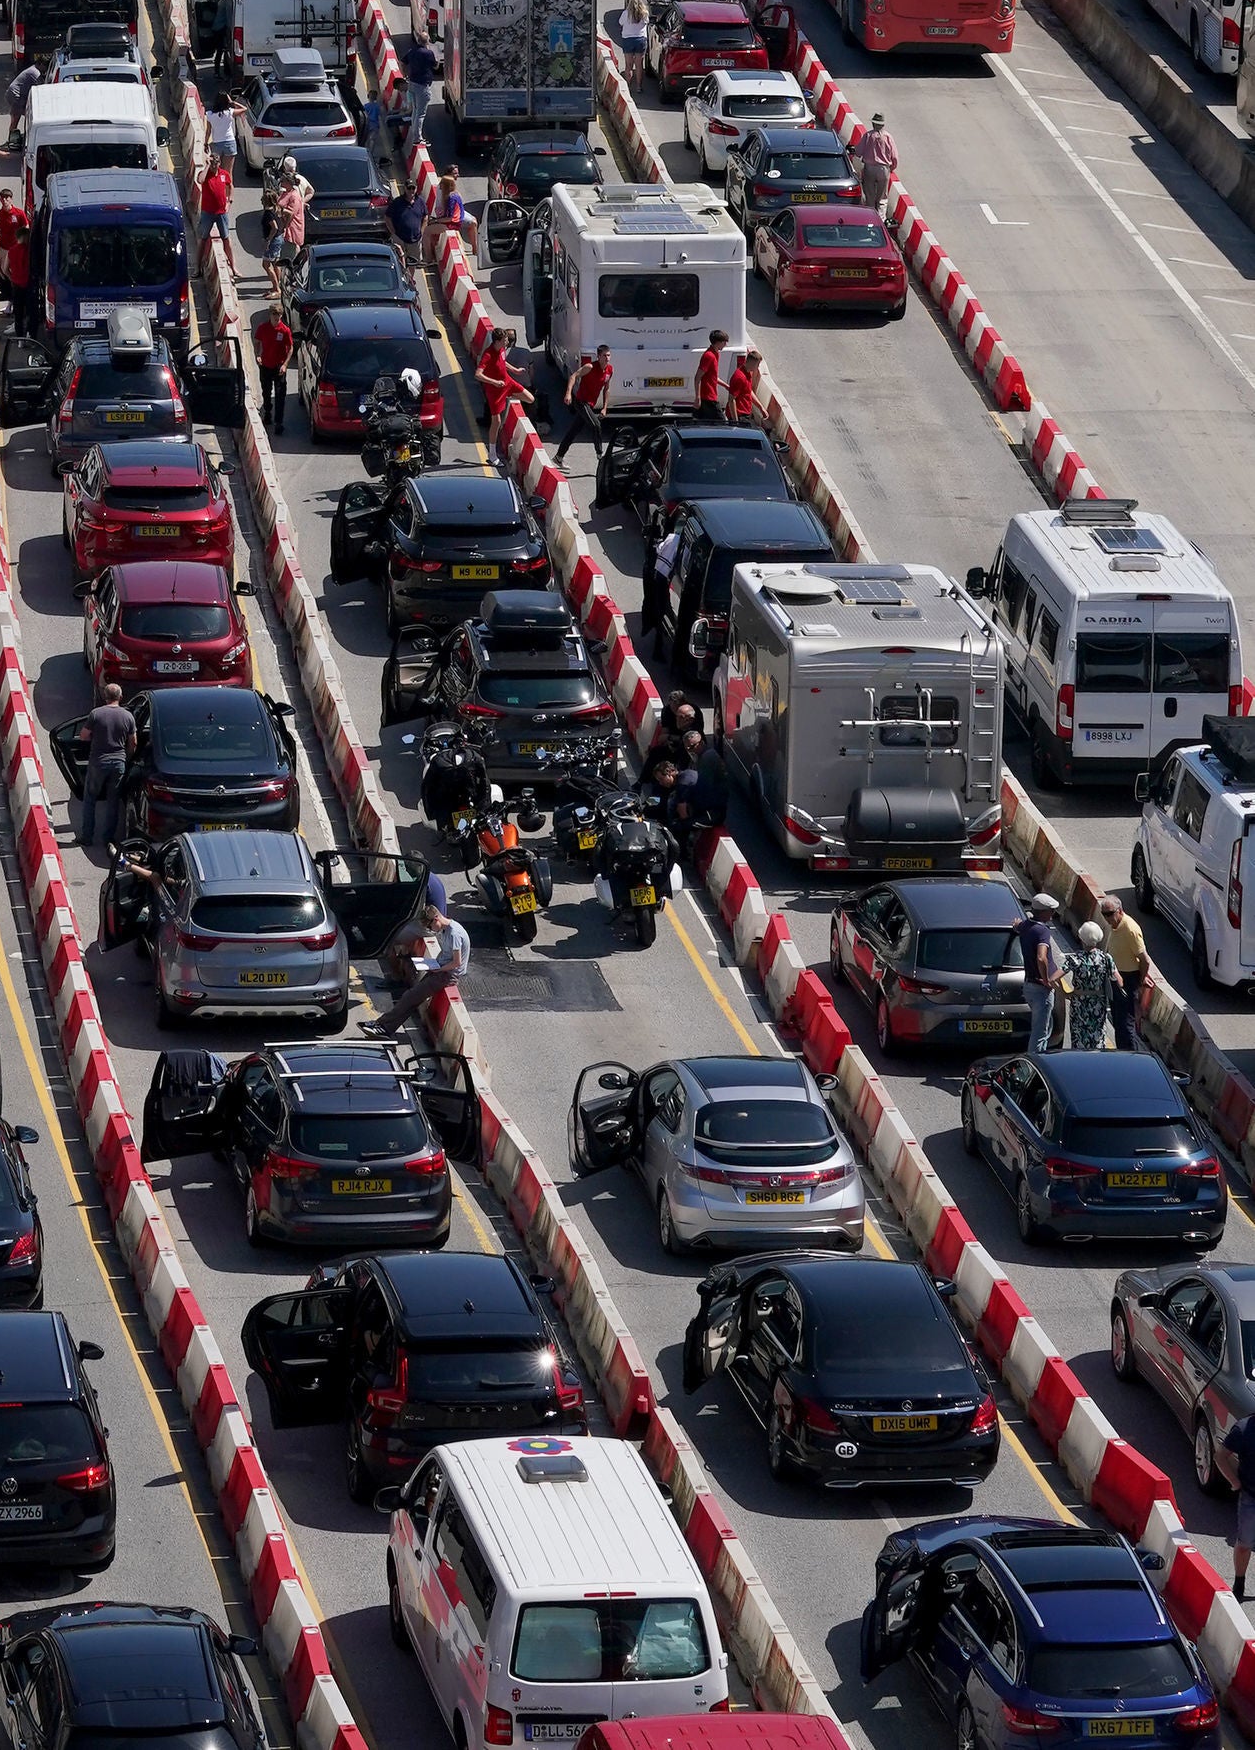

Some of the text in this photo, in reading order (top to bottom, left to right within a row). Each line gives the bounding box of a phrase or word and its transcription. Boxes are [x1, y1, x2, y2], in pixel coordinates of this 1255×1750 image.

[622, 379, 633, 388] UK
[141, 526, 177, 536] ET16 JXY
[459, 568, 471, 577] M9
[1099, 616, 1142, 624] ADRIA
[1204, 616, 1225, 624] Twin
[1091, 732, 1132, 741] 8998 LXJ
[513, 895, 532, 906] AY19
[517, 903, 533, 914] YLV
[266, 973, 287, 983] DTX
[965, 1022, 1010, 1031] KD-968-D
[1112, 1175, 1163, 1185] LM22 FXF
[337, 1182, 384, 1192] RJ14 RJX
[749, 1192, 801, 1203] SH60 BGZ
[880, 1419, 931, 1431] DX15 UMR
[837, 1444, 855, 1456] GB
[13, 1507, 42, 1518] 2966
[532, 1726, 564, 1737] D LL
[1089, 1721, 1151, 1734] HX67 TFF
